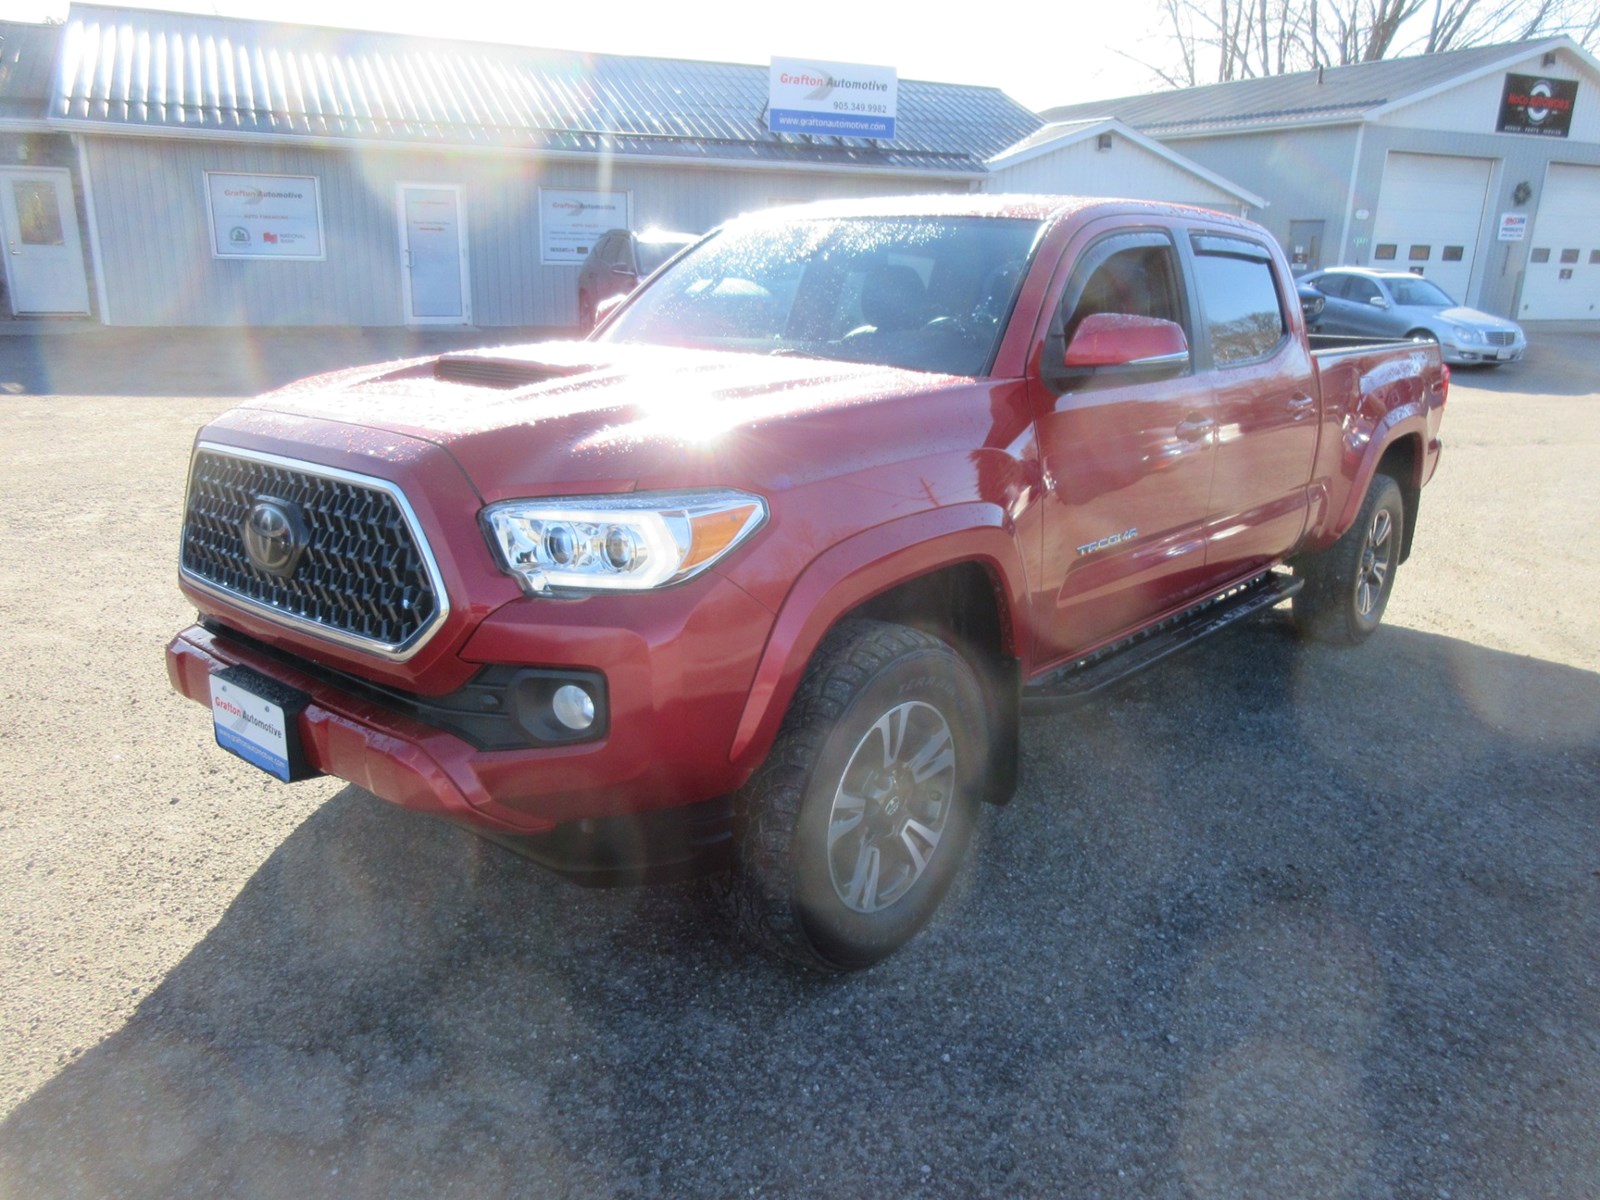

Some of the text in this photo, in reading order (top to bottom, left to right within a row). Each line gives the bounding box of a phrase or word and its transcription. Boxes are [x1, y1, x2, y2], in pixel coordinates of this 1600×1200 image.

[780, 73, 888, 92] Grafton Automotive
[833, 101, 887, 114] 905.349.9982
[779, 116, 886, 131] www.graftonautomotive.com
[224, 189, 303, 199] Grafton Automotive
[1077, 528, 1137, 555] TACOMA
[215, 697, 282, 738] Grafton Automotive
